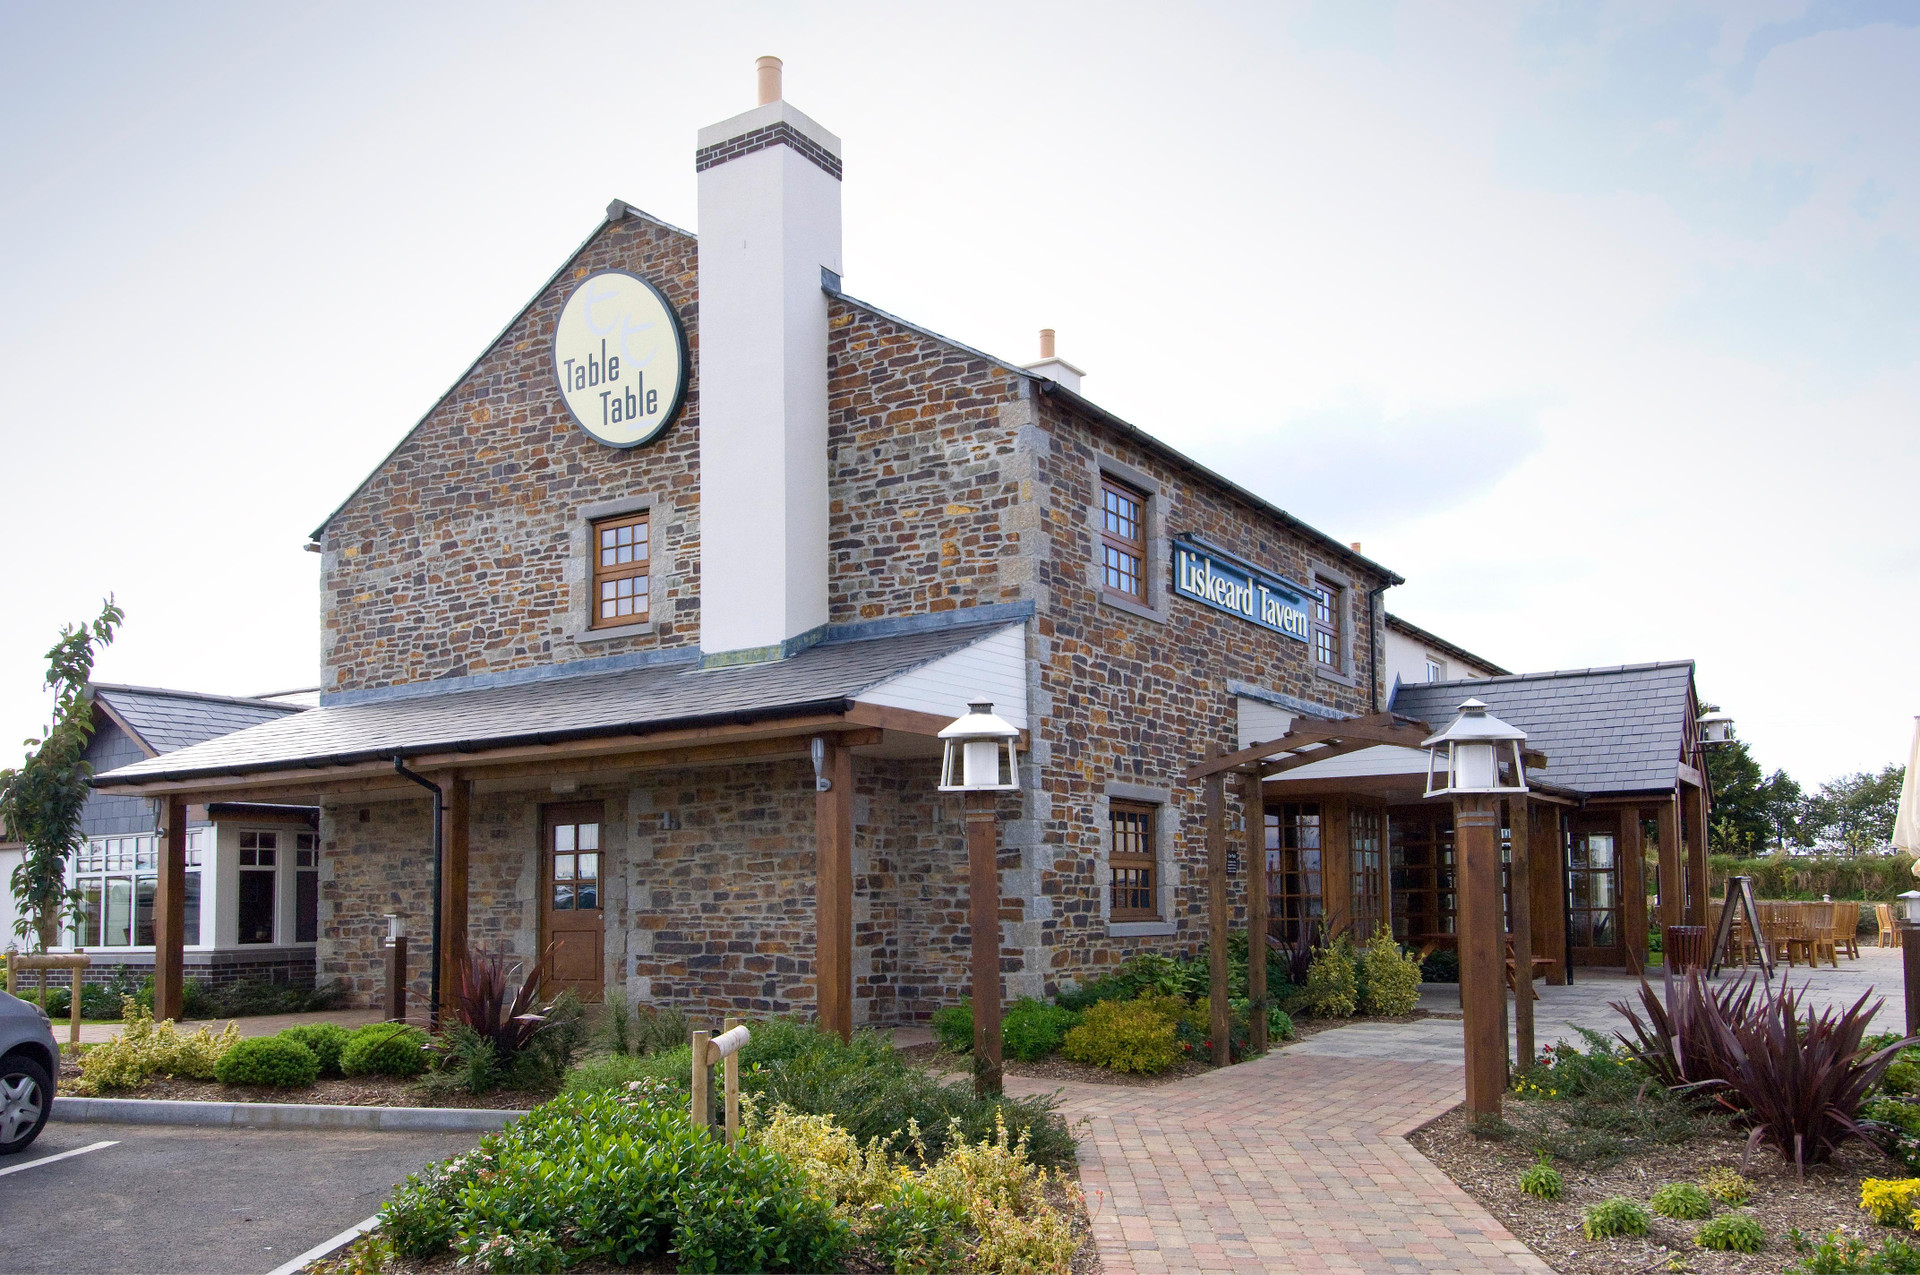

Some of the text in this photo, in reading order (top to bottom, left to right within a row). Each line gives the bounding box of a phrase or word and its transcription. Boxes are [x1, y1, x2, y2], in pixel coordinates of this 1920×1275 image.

[564, 338, 620, 393] Table
[599, 370, 658, 426] Table
[1180, 551, 1307, 637] Liskeard Tavern
